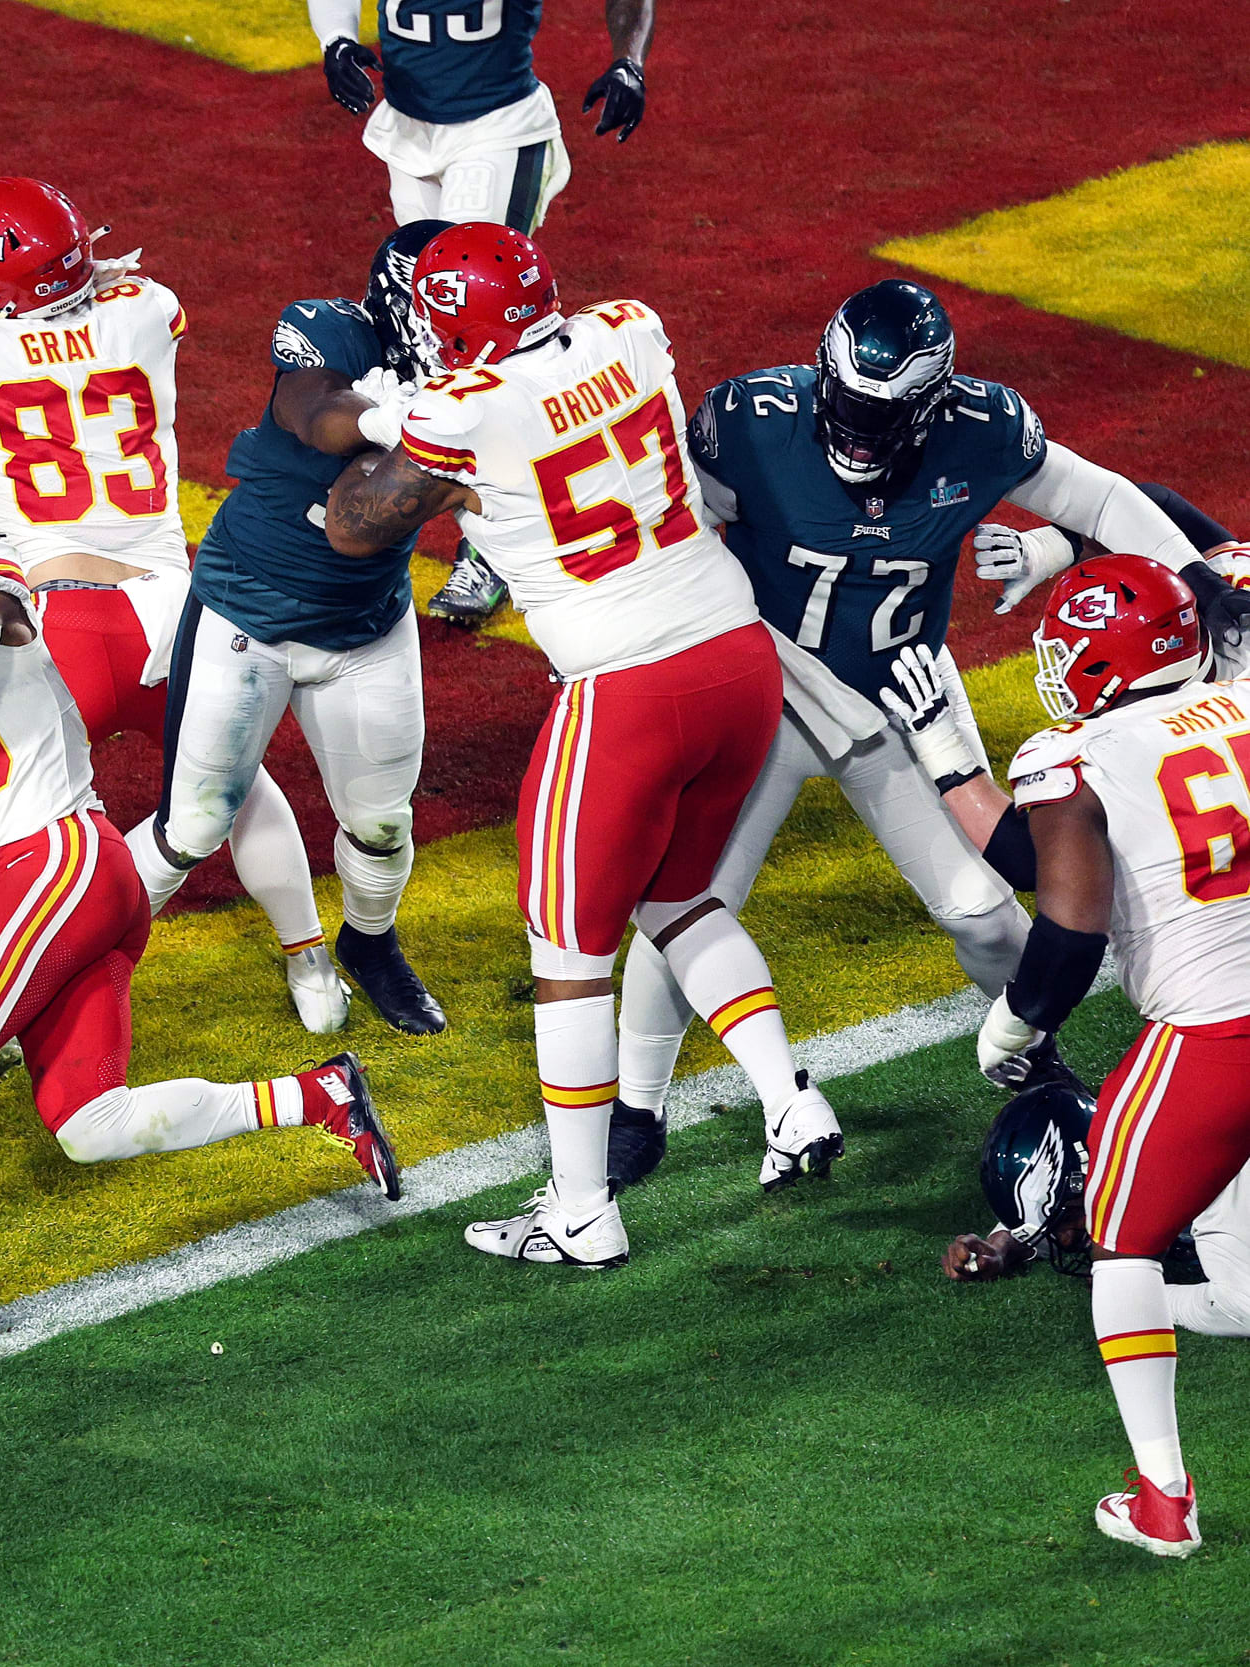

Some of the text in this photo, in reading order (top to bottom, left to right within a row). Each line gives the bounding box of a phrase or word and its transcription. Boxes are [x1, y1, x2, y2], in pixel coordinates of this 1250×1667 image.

[37, 285, 49, 295] 16
[507, 308, 518, 320] 16
[20, 325, 96, 366] GRAY
[542, 360, 640, 437] BROWN
[746, 373, 799, 416] 72
[530, 387, 700, 586] 57
[851, 524, 892, 541] EAGLES
[785, 544, 932, 653] 72
[1154, 640, 1166, 652] 16
[1159, 695, 1245, 736] SMITH
[1153, 731, 1250, 905] 6
[527, 1241, 557, 1252] ALPHA
